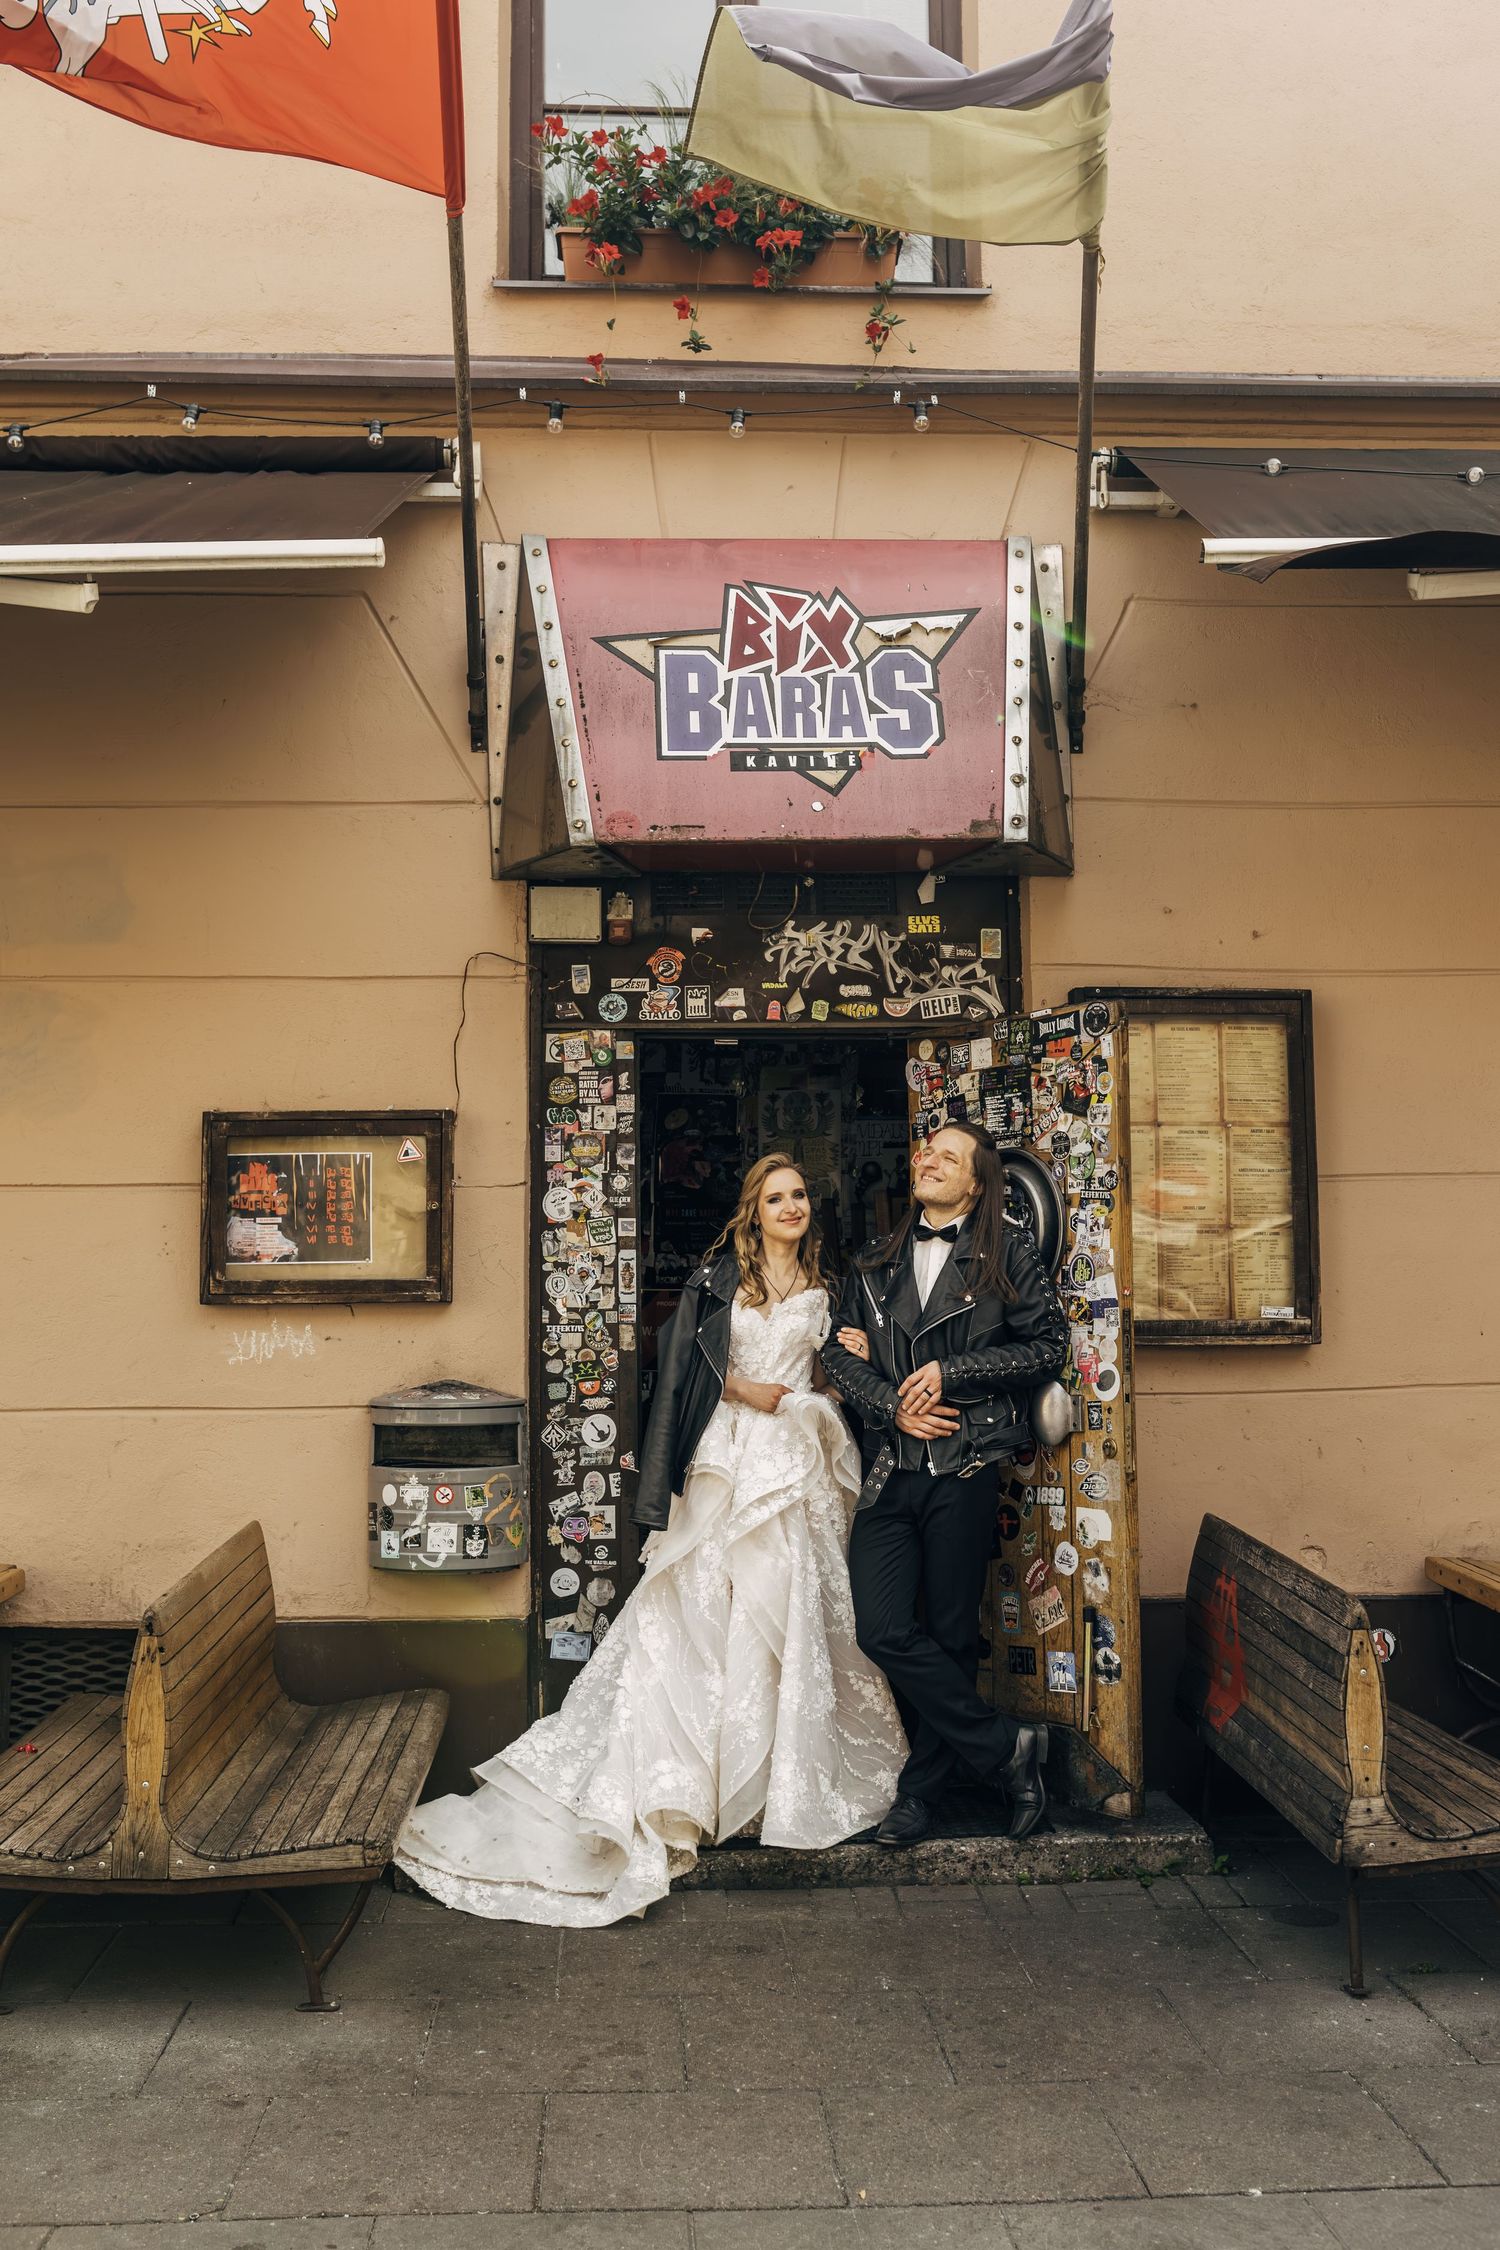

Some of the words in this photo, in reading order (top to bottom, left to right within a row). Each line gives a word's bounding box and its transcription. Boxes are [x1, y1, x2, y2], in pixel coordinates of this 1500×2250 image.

[726, 590, 856, 677] BIX
[661, 651, 937, 756] BARAS
[746, 751, 856, 769] KAVINĖ
[907, 915, 940, 925] ELVS
[625, 980, 647, 989] SESH
[921, 997, 952, 1017] HELP
[640, 1010, 681, 1019] STAYLO
[578, 1080, 598, 1089] RATED
[578, 1089, 588, 1098] BY
[588, 1089, 600, 1098] ALL
[307, 1214, 316, 1222] V
[306, 1225, 318, 1233] VI
[1036, 1486, 1065, 1505] 1899
